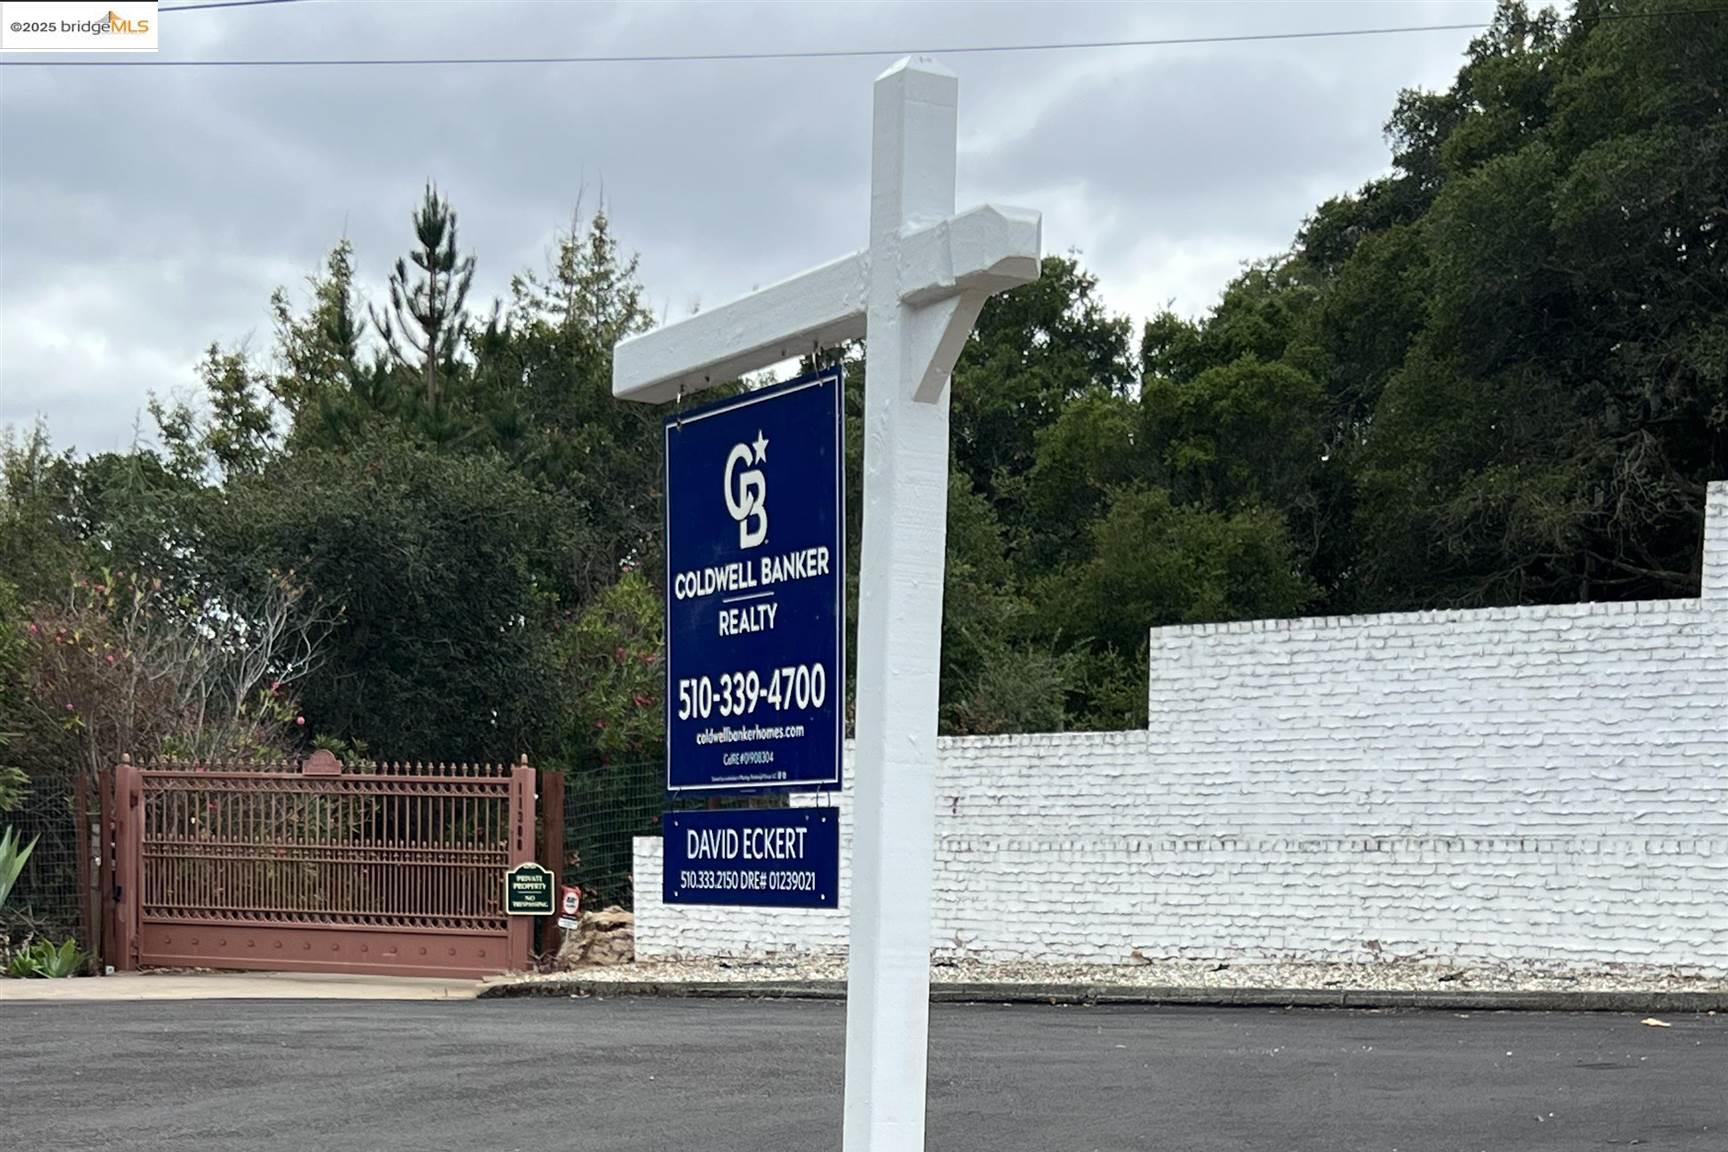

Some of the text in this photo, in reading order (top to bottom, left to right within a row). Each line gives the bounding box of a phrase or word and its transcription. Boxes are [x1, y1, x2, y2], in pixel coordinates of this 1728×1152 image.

[675, 546, 829, 600] COLDWELL BANKER
[719, 603, 778, 636] REALTY
[678, 663, 826, 720] 510-339-4700
[696, 724, 805, 745] coldwellbankerhomes.com
[687, 827, 808, 859] DAVID ECKERT
[513, 882, 546, 890] PROPERTY
[680, 871, 816, 890] 510.333.2150 DRE# 01239021
